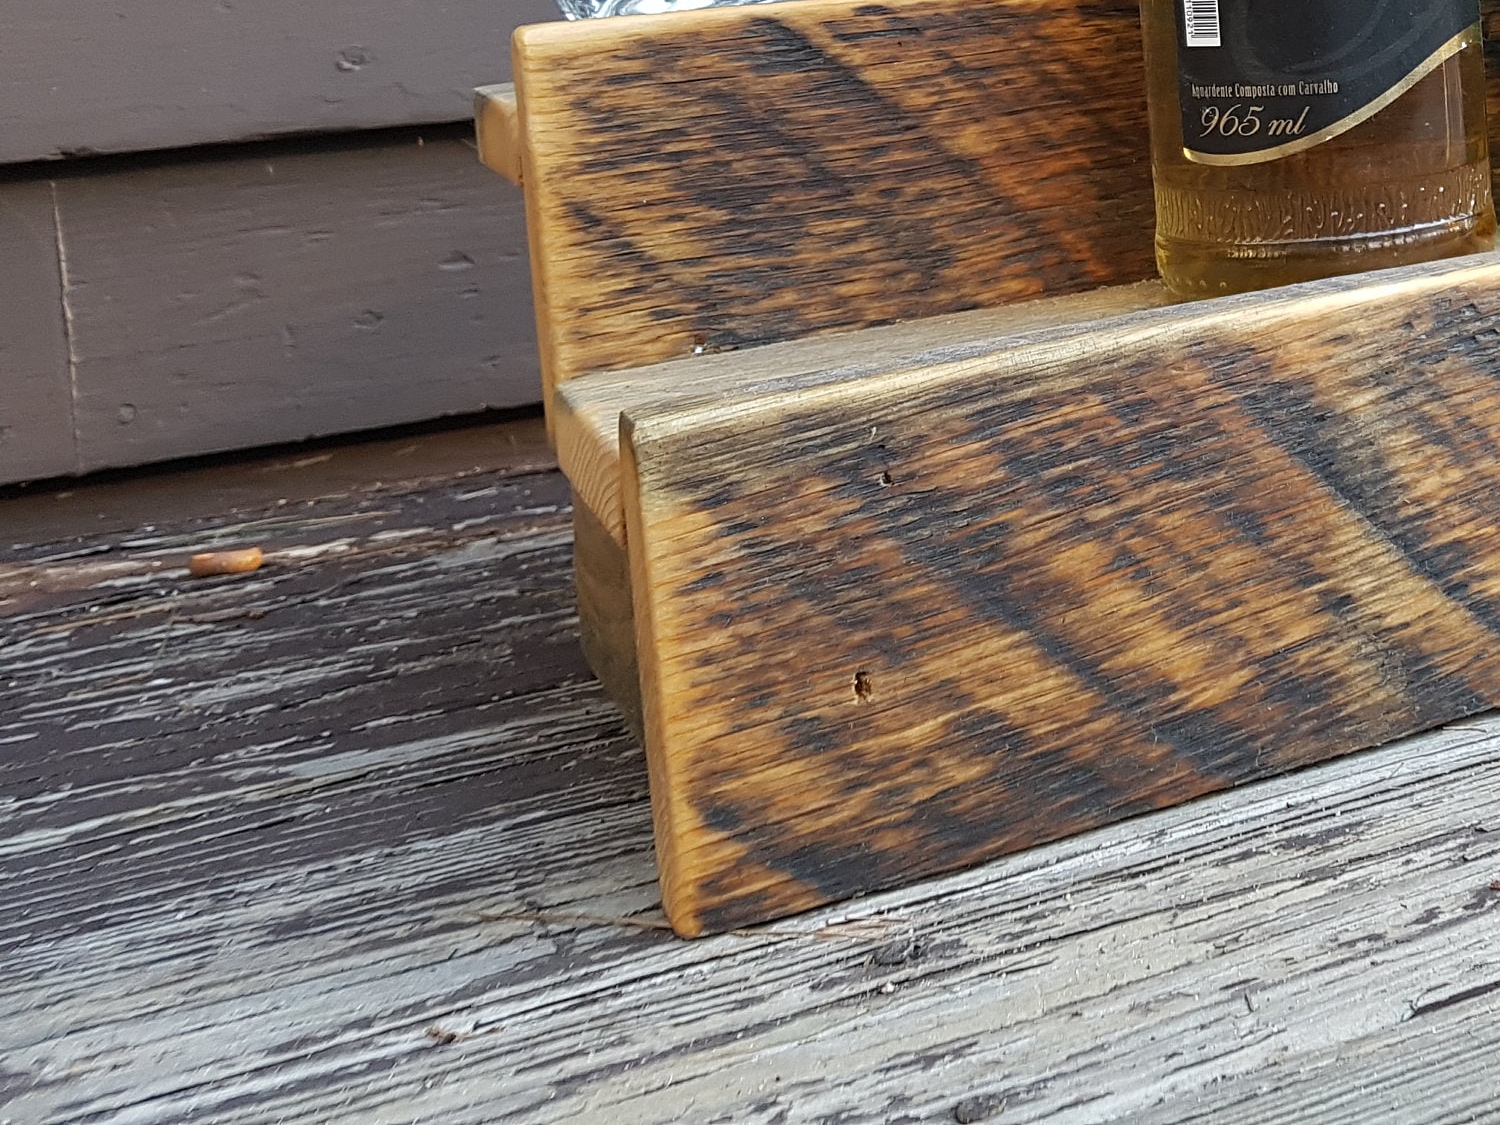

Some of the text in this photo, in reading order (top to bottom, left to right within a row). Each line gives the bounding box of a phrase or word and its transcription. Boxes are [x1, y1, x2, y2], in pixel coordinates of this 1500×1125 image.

[1234, 82, 1276, 99] Composta
[1278, 83, 1297, 96] com
[1299, 79, 1339, 95] Carvalho
[1200, 104, 1311, 137] 965 ml
